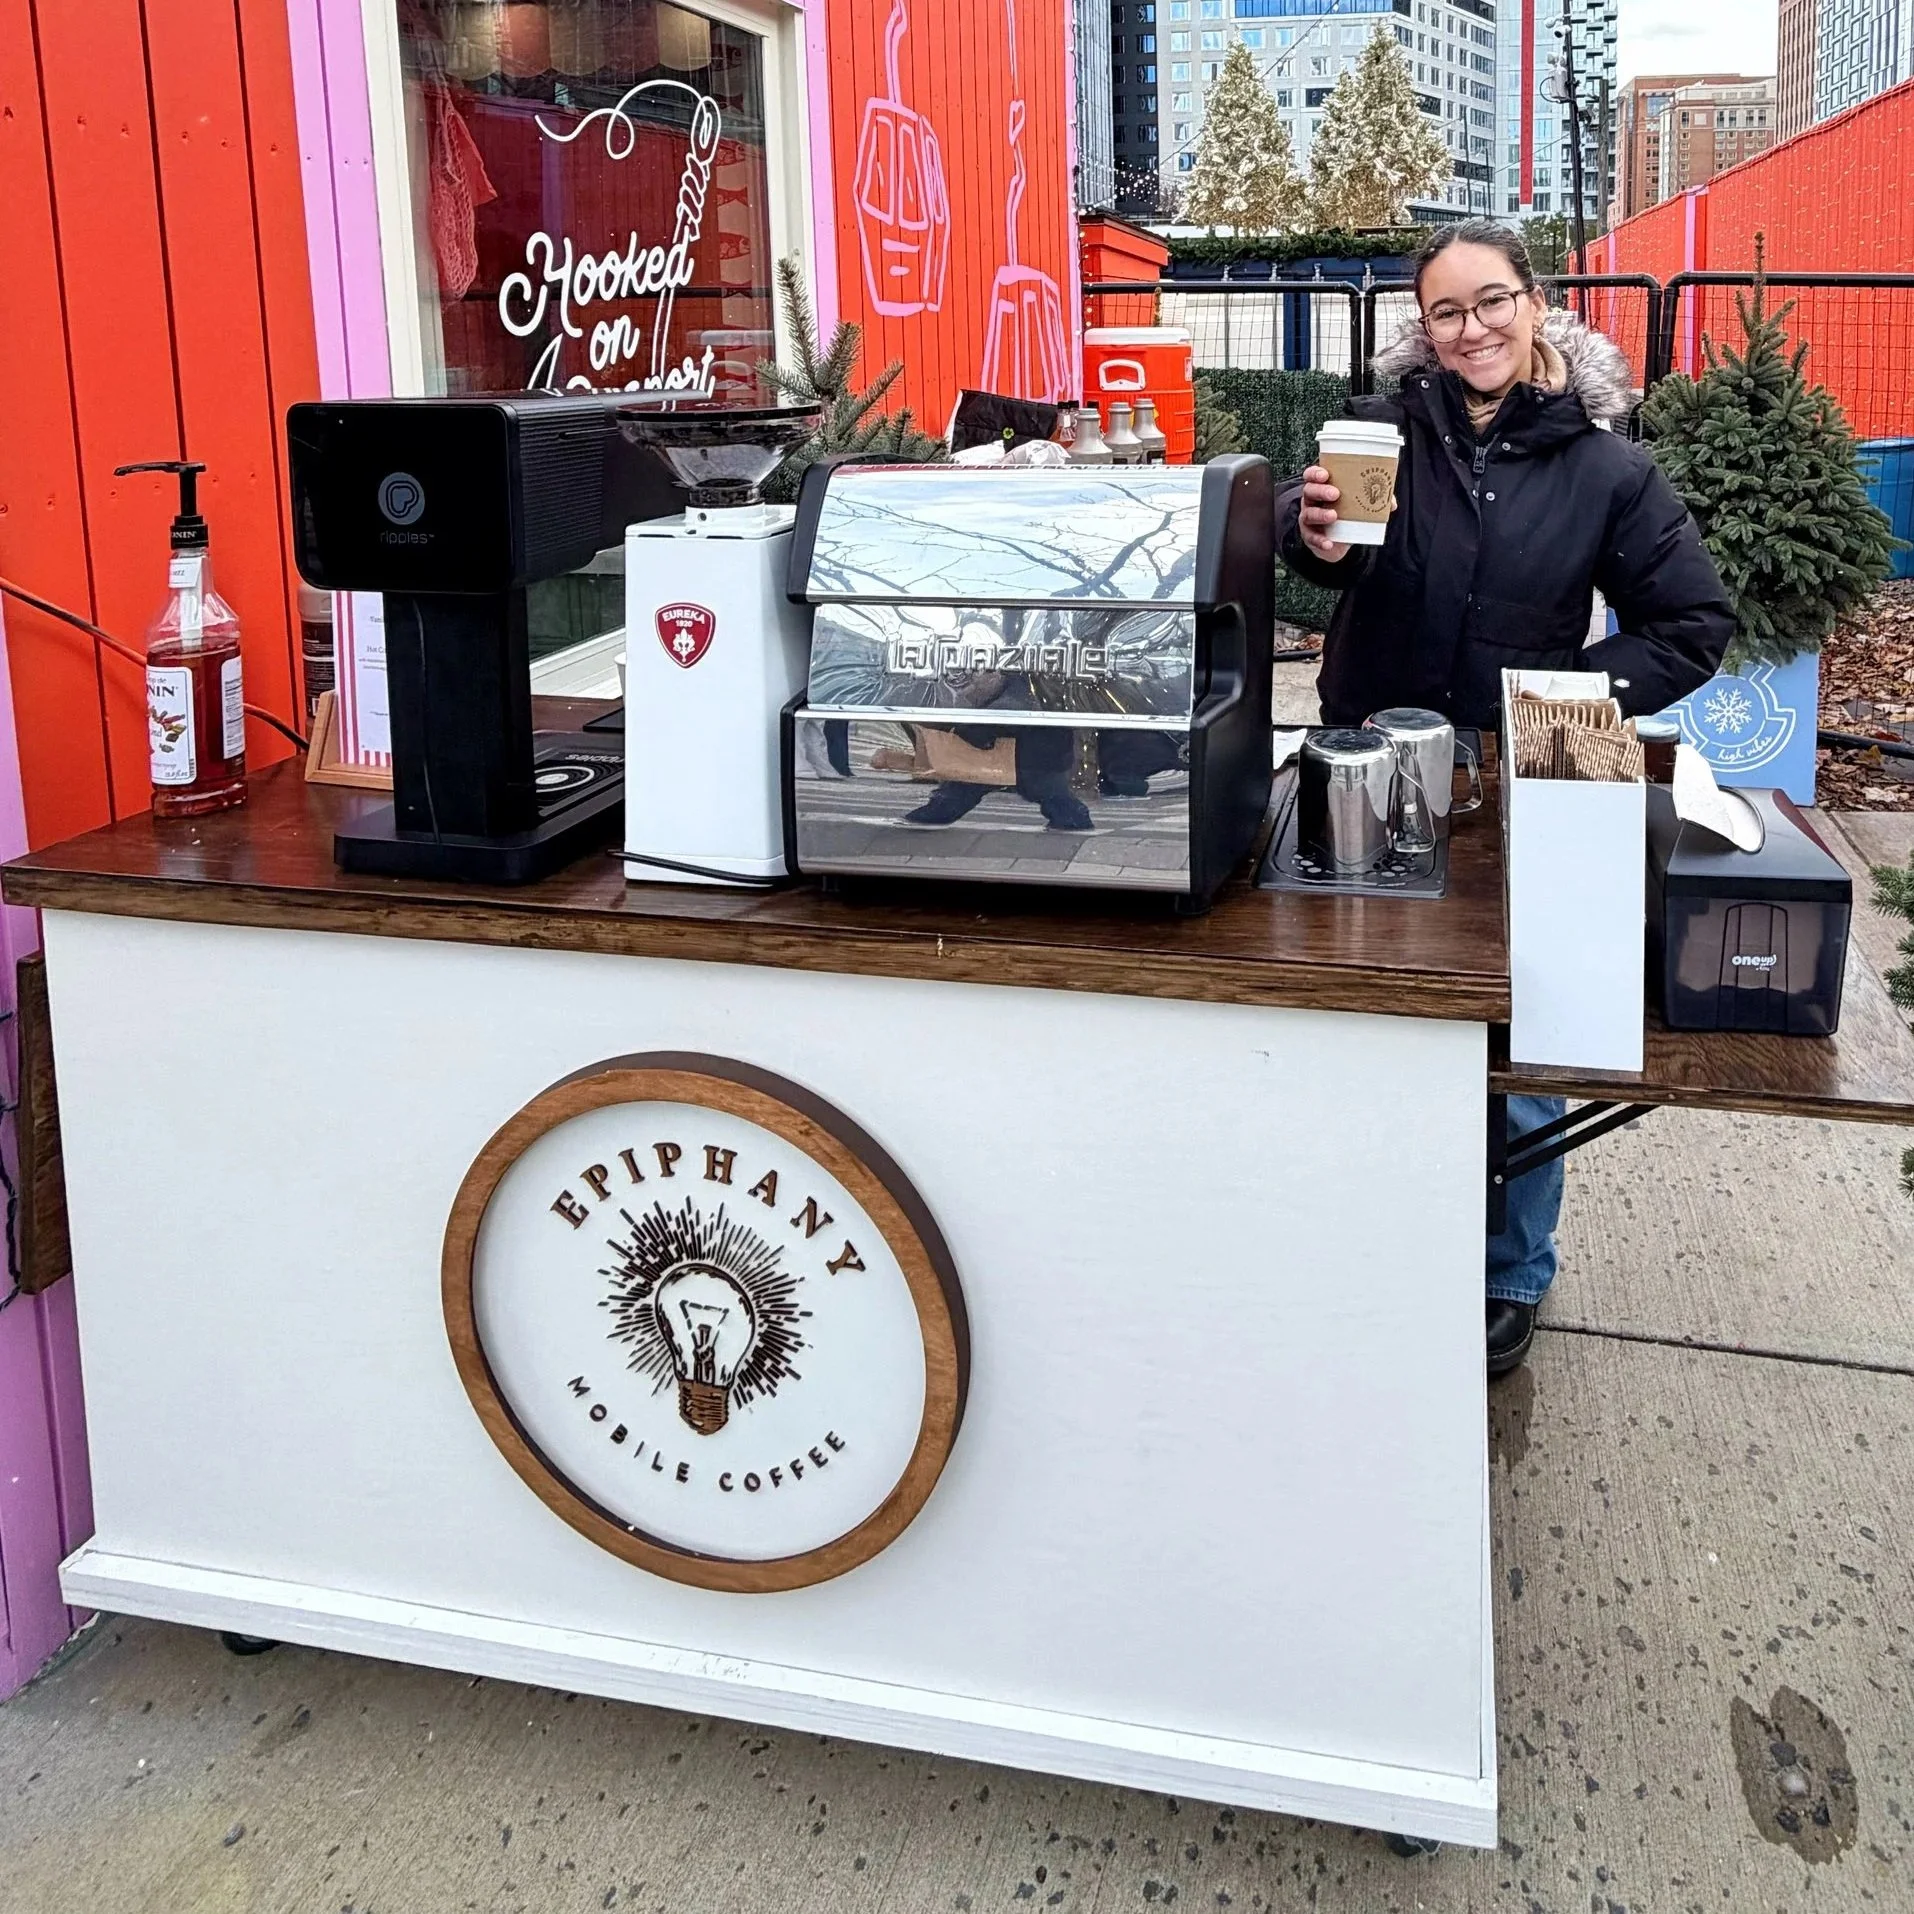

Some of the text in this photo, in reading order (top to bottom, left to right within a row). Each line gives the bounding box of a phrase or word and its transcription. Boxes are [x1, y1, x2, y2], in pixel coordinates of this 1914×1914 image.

[498, 226, 695, 338] Hooked
[589, 315, 641, 371] on
[662, 609, 705, 625] EUREKA
[550, 1142, 866, 1276] EPIPHANY
[567, 1376, 846, 1492] MOBILE COFFEE
